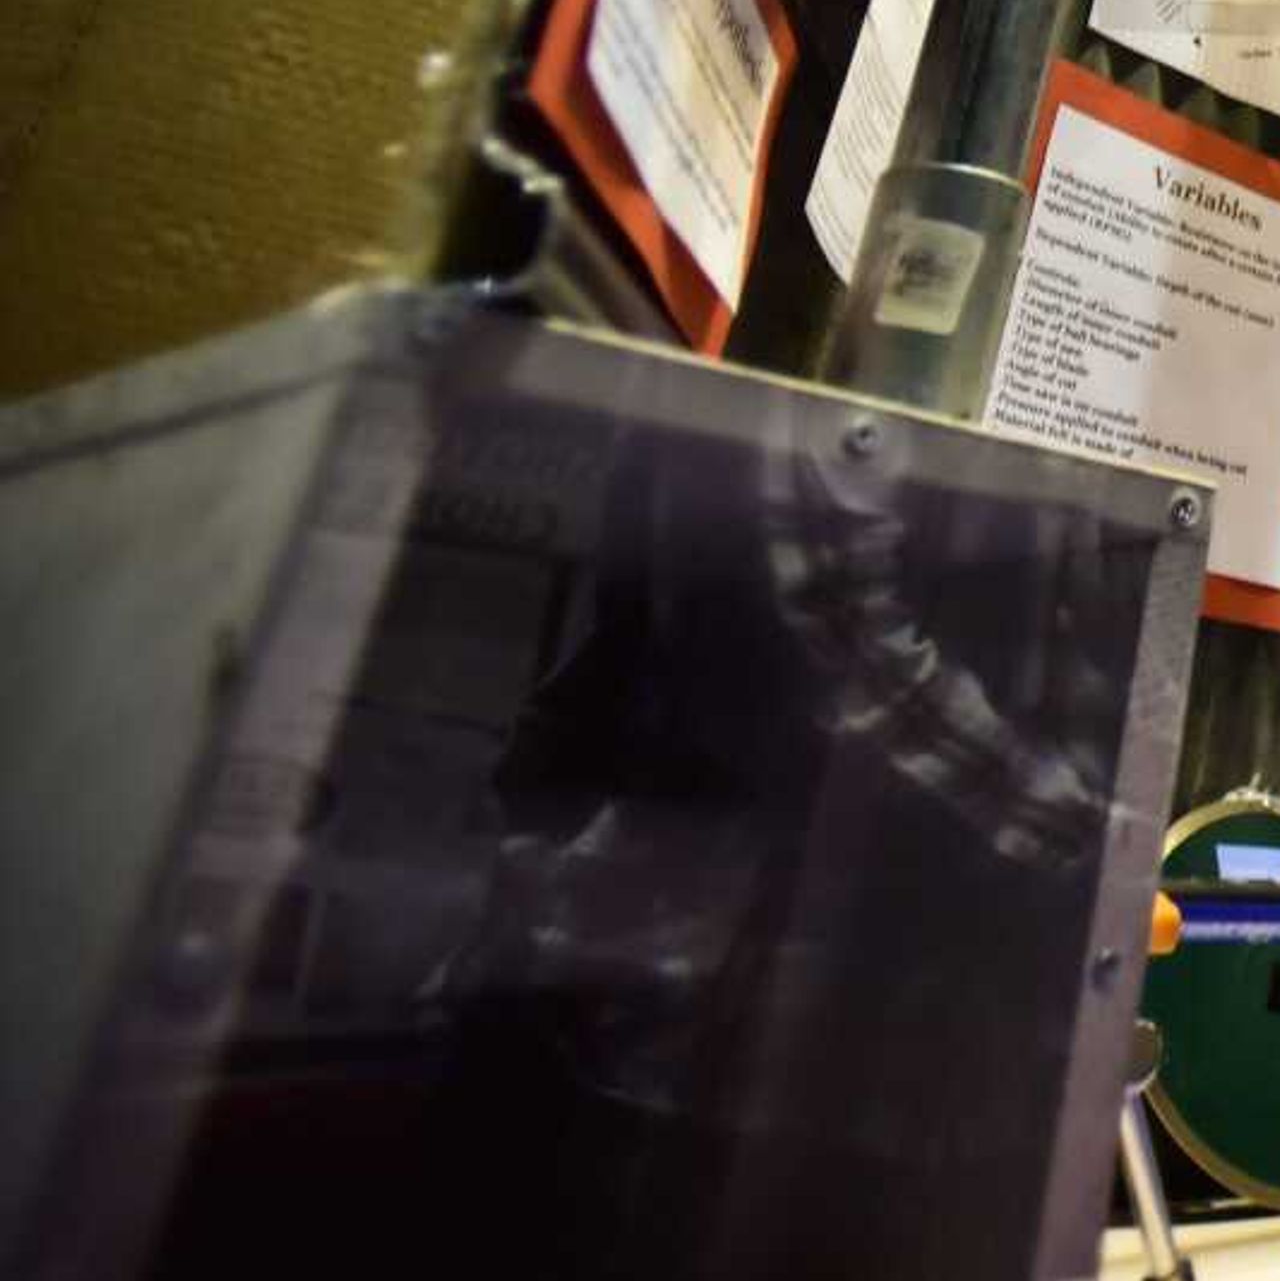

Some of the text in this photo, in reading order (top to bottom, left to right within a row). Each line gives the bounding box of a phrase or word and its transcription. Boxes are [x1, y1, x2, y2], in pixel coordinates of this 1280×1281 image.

[1052, 168, 1124, 205] Independent
[1155, 164, 1264, 232] Variables
[1037, 226, 1098, 261] Dependent
[1023, 292, 1064, 315] Length
[1114, 329, 1160, 349] conduit
[1134, 319, 1177, 339] conduit
